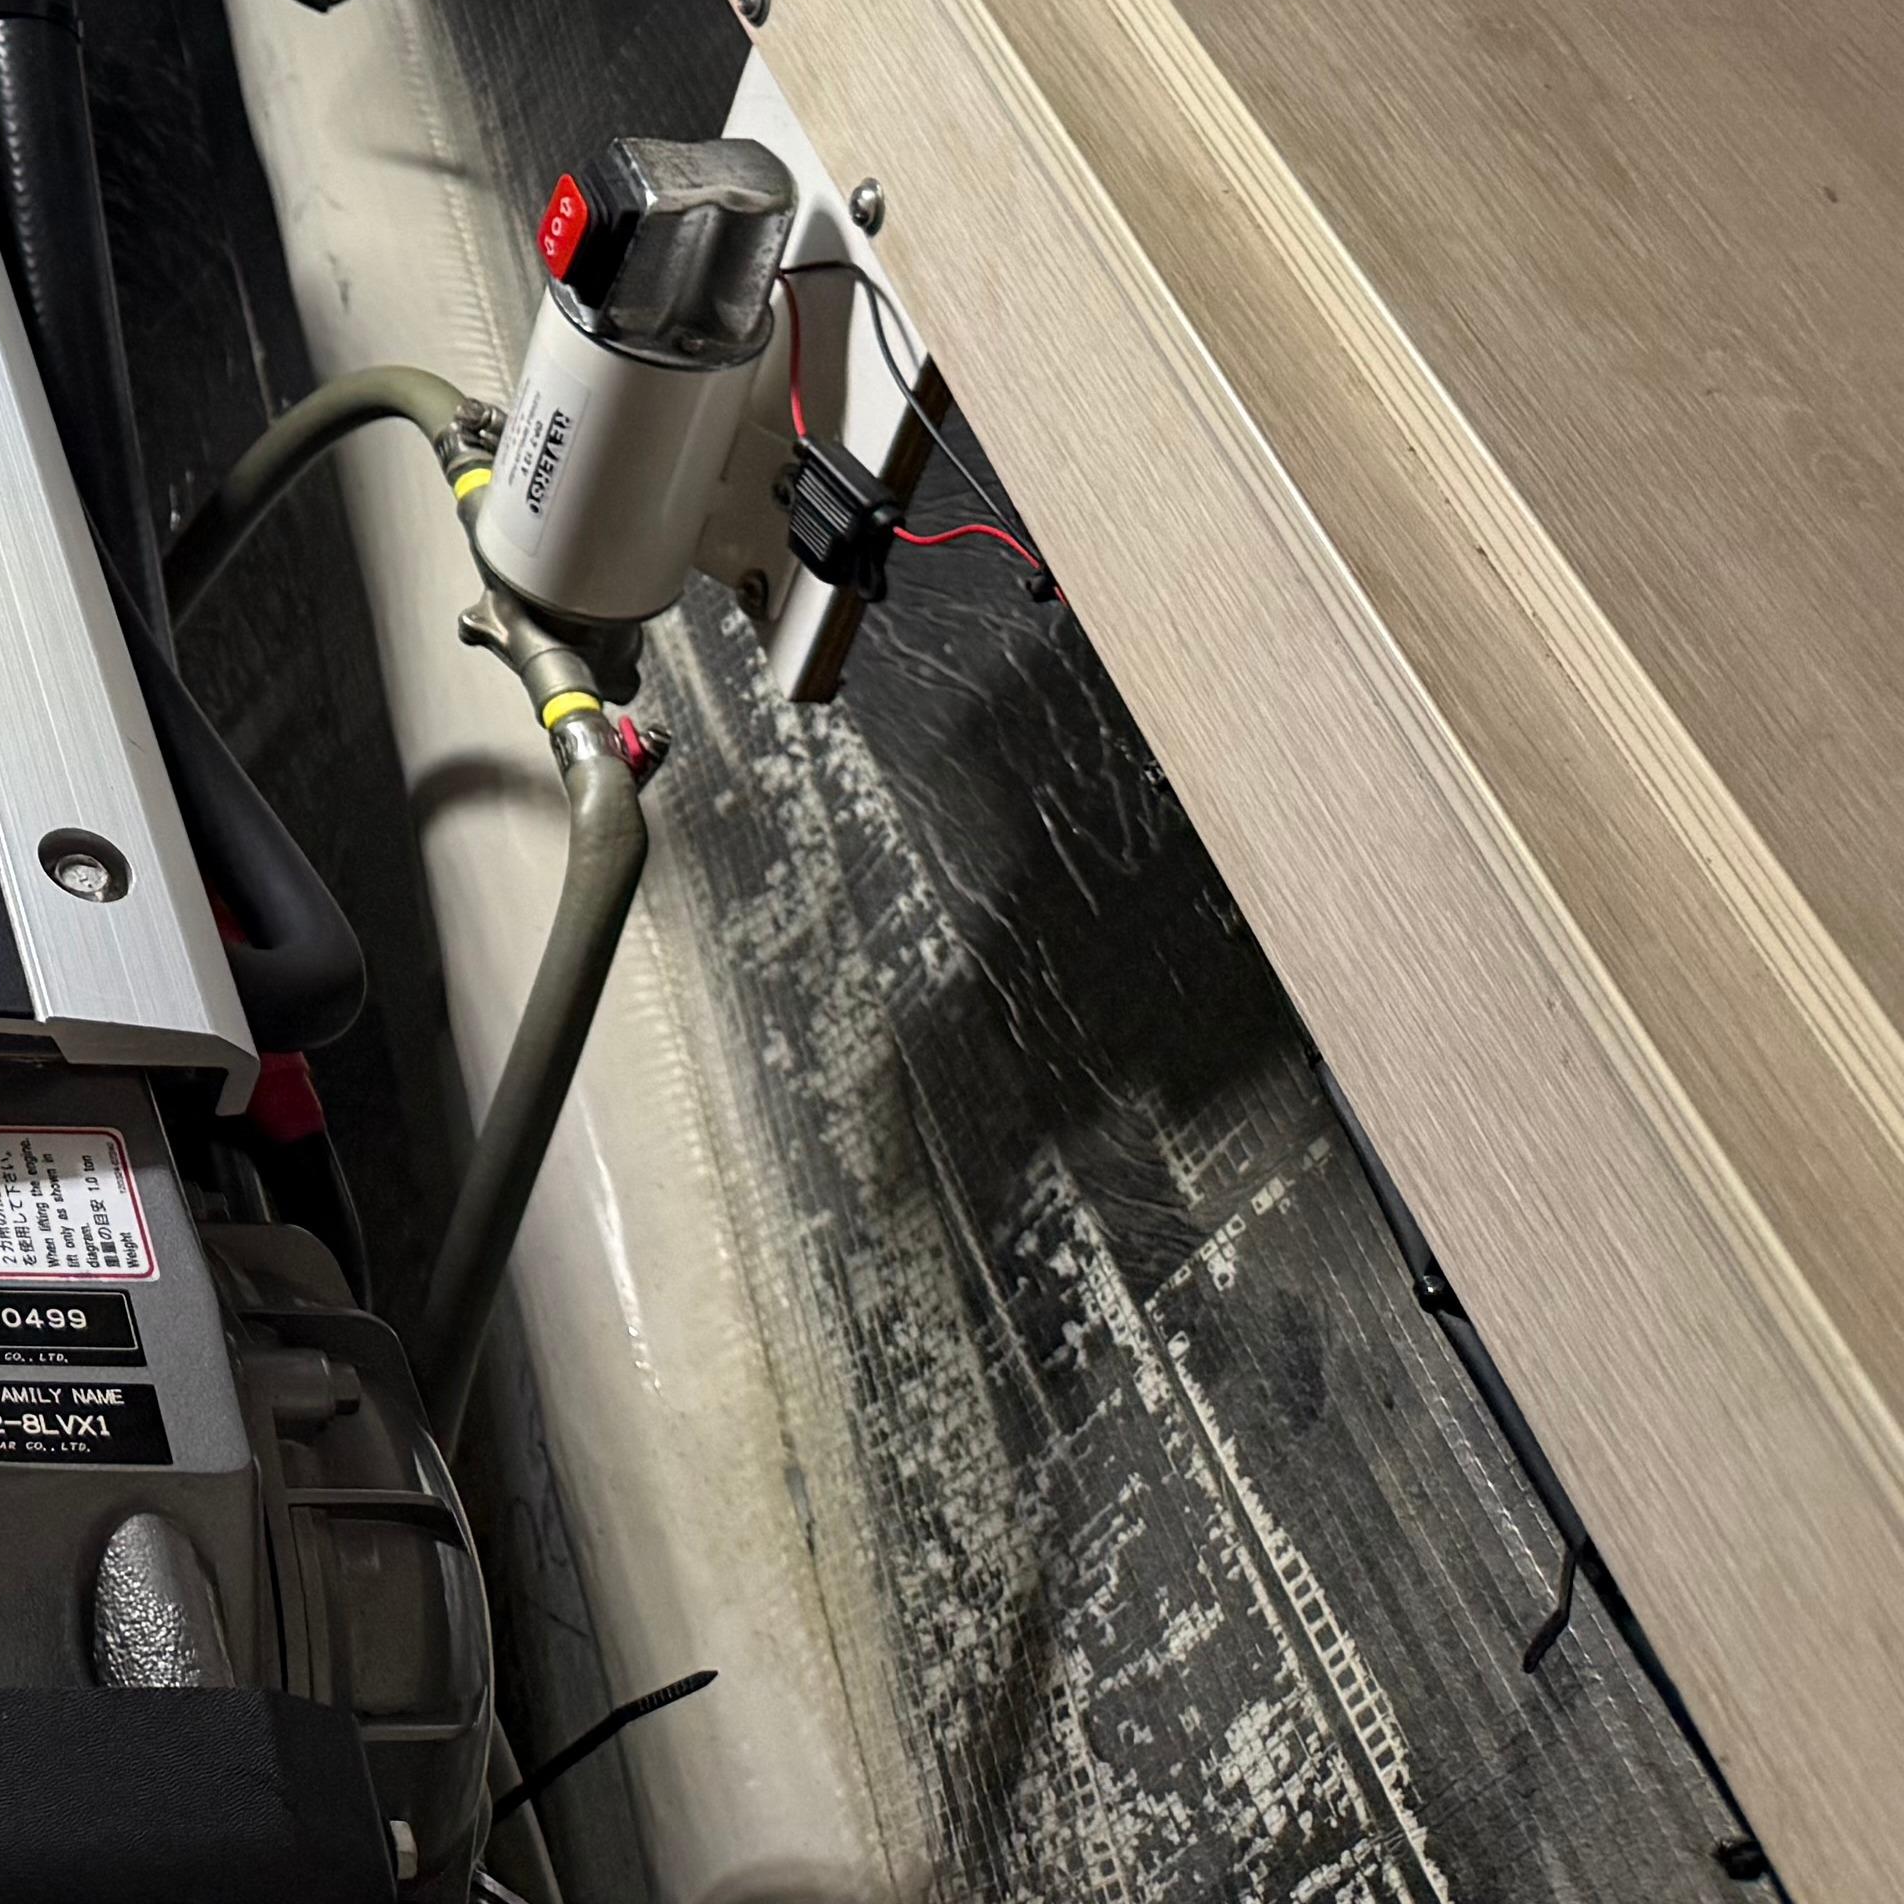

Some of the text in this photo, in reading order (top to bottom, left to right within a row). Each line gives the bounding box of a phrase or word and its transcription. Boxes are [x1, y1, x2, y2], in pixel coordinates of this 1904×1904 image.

[526, 408, 571, 515] REVERSO
[43, 1153, 55, 1163] in
[82, 1155, 95, 1172] ton
[30, 1180, 43, 1197] the
[47, 1168, 65, 1203] shown
[36, 1202, 52, 1233] lifting
[57, 1208, 69, 1221] as
[61, 1226, 75, 1249] only
[45, 1237, 61, 1268] When
[120, 1232, 140, 1268] Weight
[1, 1307, 87, 1330] 0499
[39, 1352, 69, 1363] LTD.
[72, 1388, 125, 1406] NAME
[61, 1441, 91, 1453] LTD.
